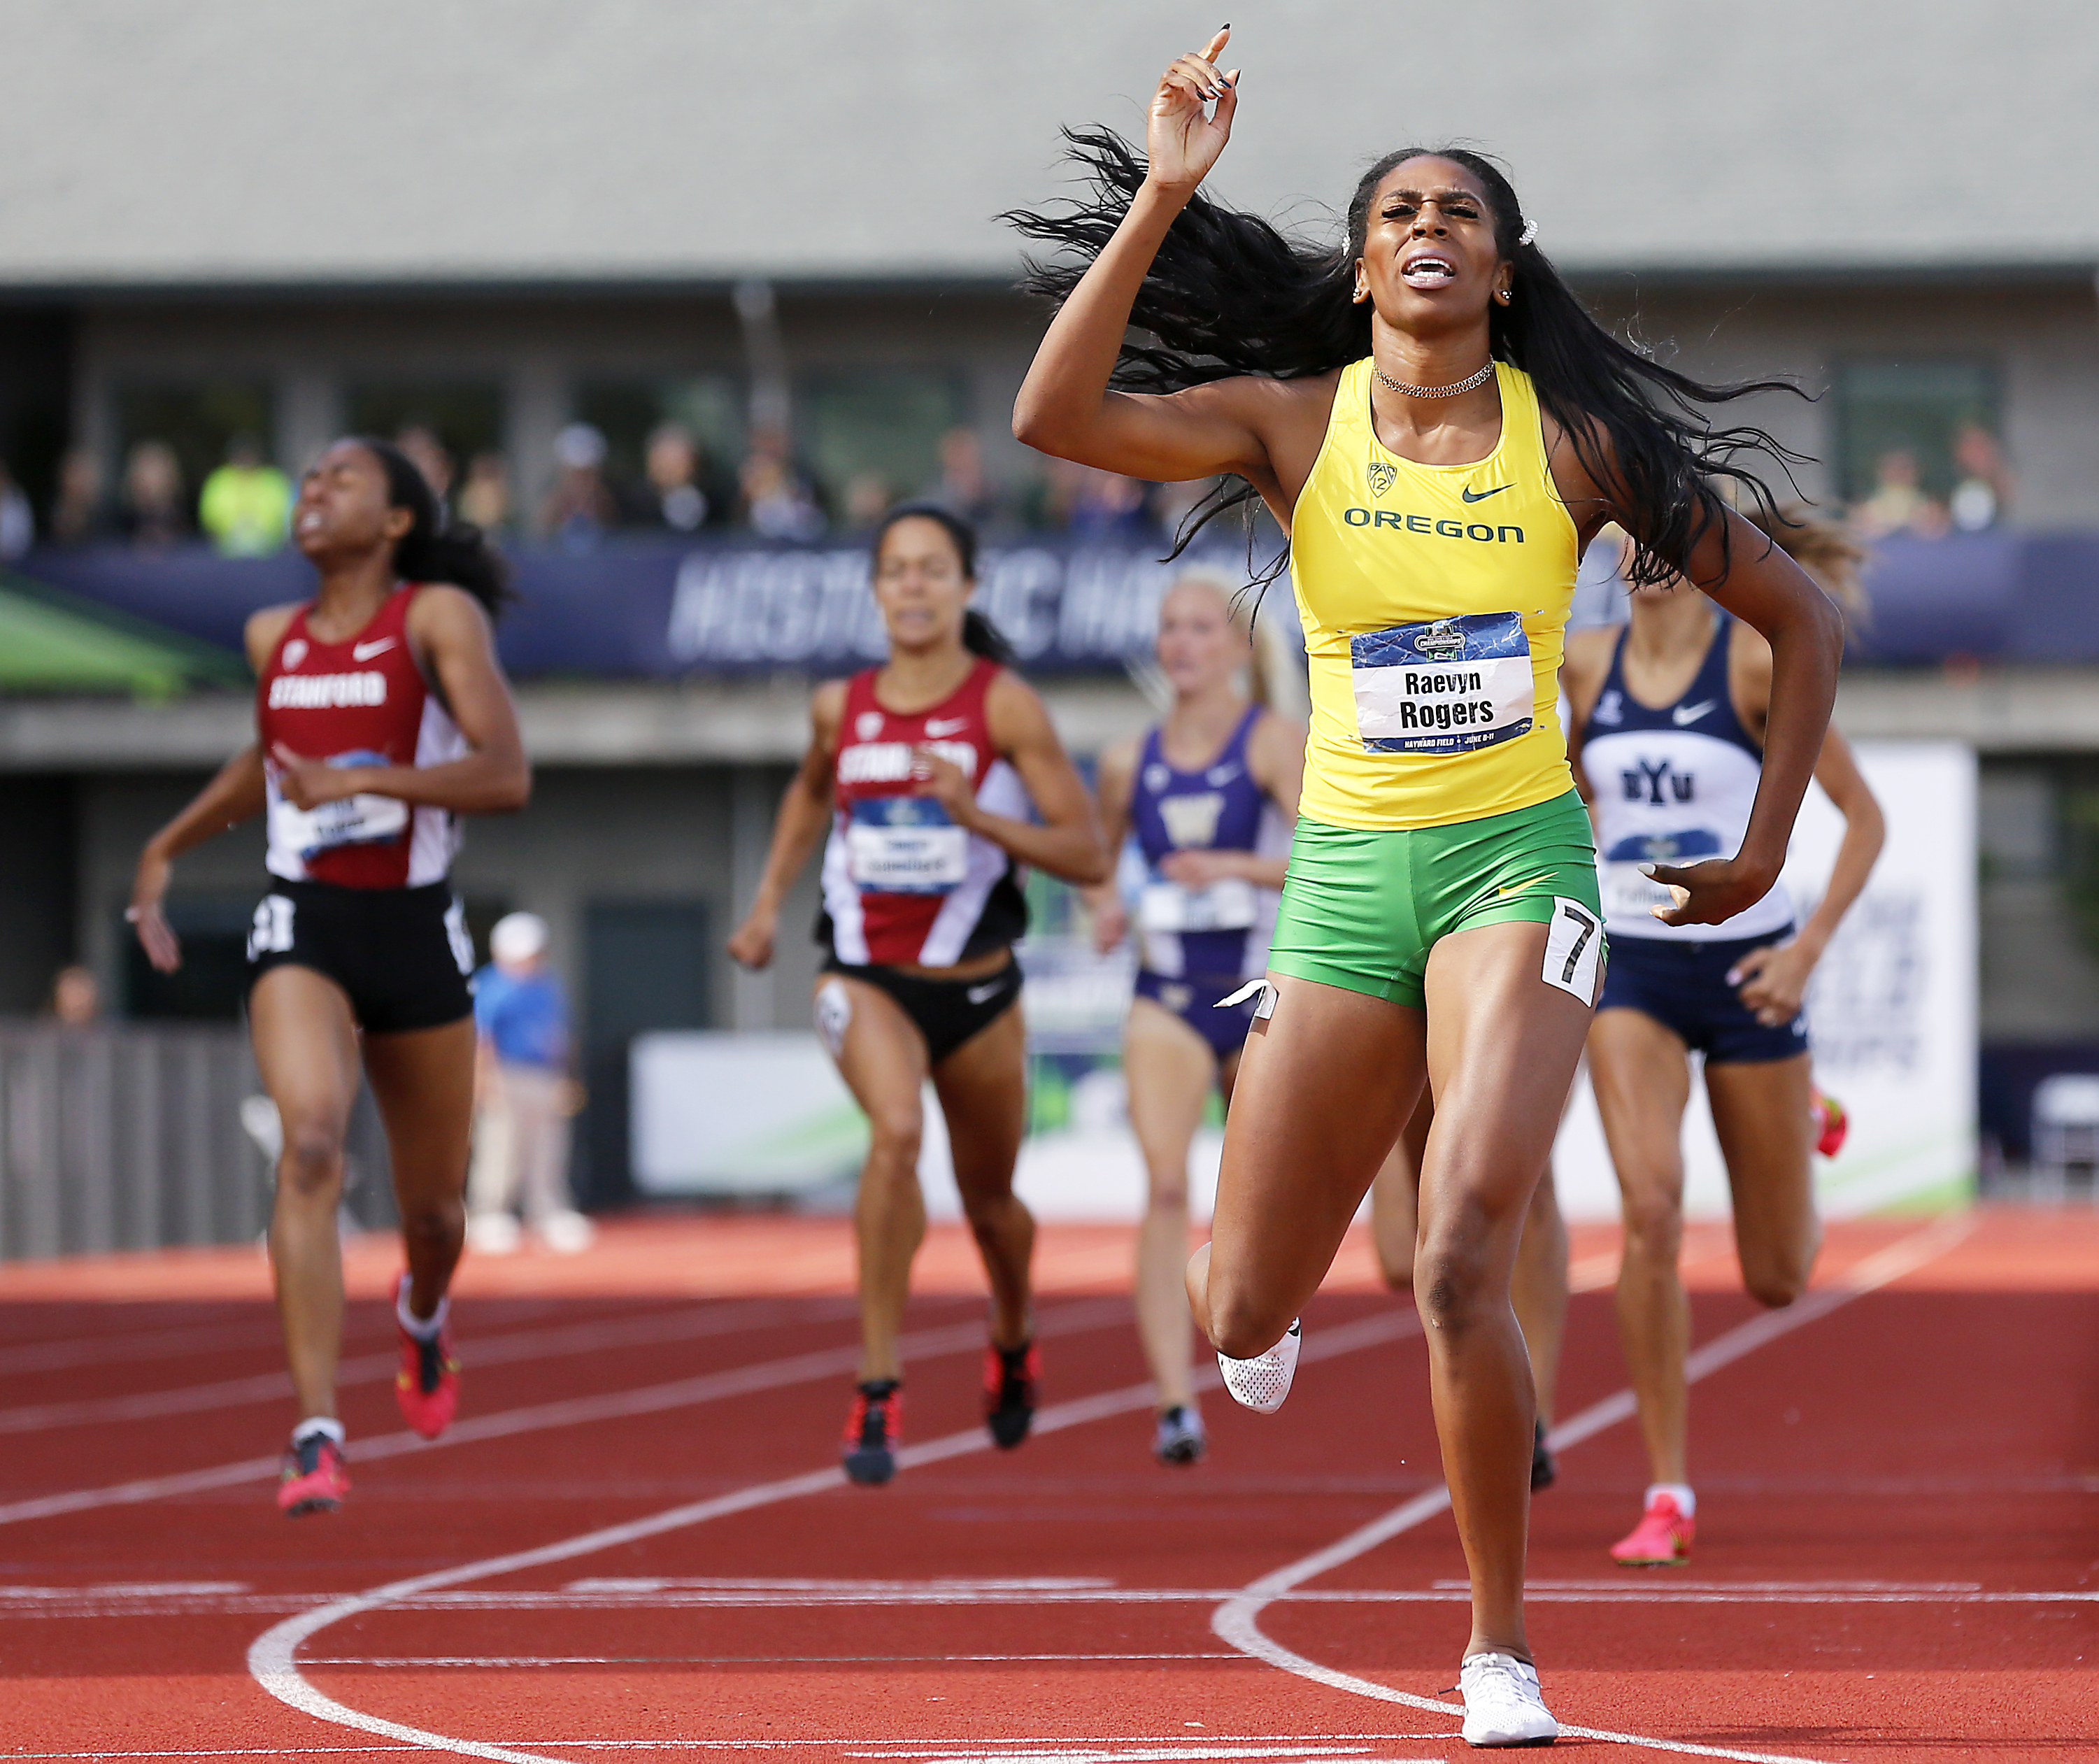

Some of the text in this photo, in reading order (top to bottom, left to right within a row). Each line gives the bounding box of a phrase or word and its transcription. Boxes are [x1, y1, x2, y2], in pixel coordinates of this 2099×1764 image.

[1369, 464, 1395, 484] PAC
[1372, 477, 1386, 490] 12
[1344, 508, 1524, 543] OREGON
[1405, 672, 1481, 695] Raevyn
[1400, 700, 1494, 730] Rogers
[1404, 739, 1436, 748] HAYWARD
[1436, 738, 1454, 746] FIELD
[1464, 734, 1481, 744] JUNE
[1622, 758, 1695, 805] BYU
[1561, 905, 1595, 984] 7
